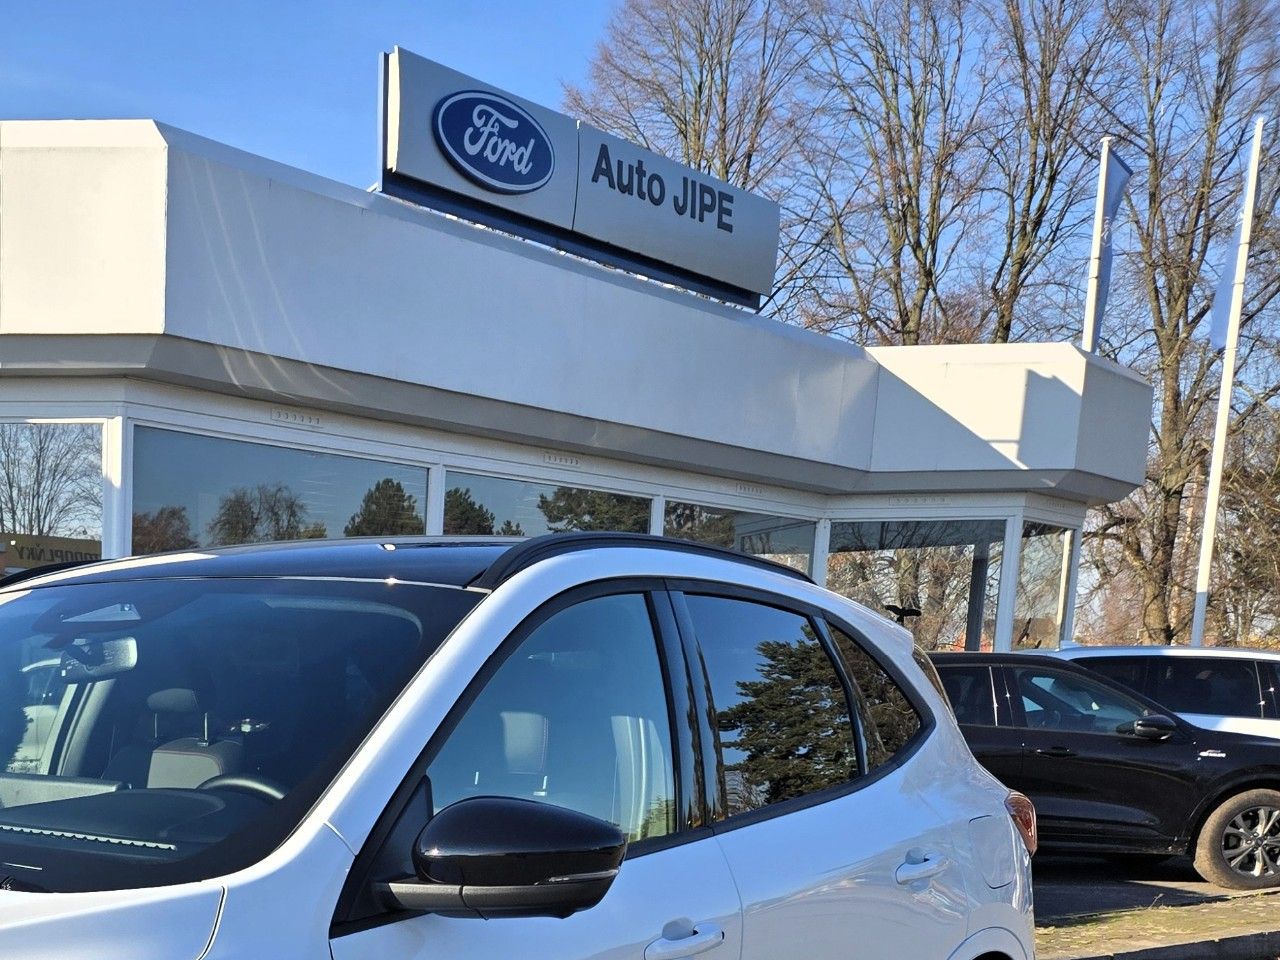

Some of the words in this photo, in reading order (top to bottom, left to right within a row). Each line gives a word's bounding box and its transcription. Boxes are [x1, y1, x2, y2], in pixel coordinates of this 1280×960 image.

[464, 104, 535, 175] Ford
[591, 143, 666, 206] Auto
[673, 176, 734, 234] JIPE
